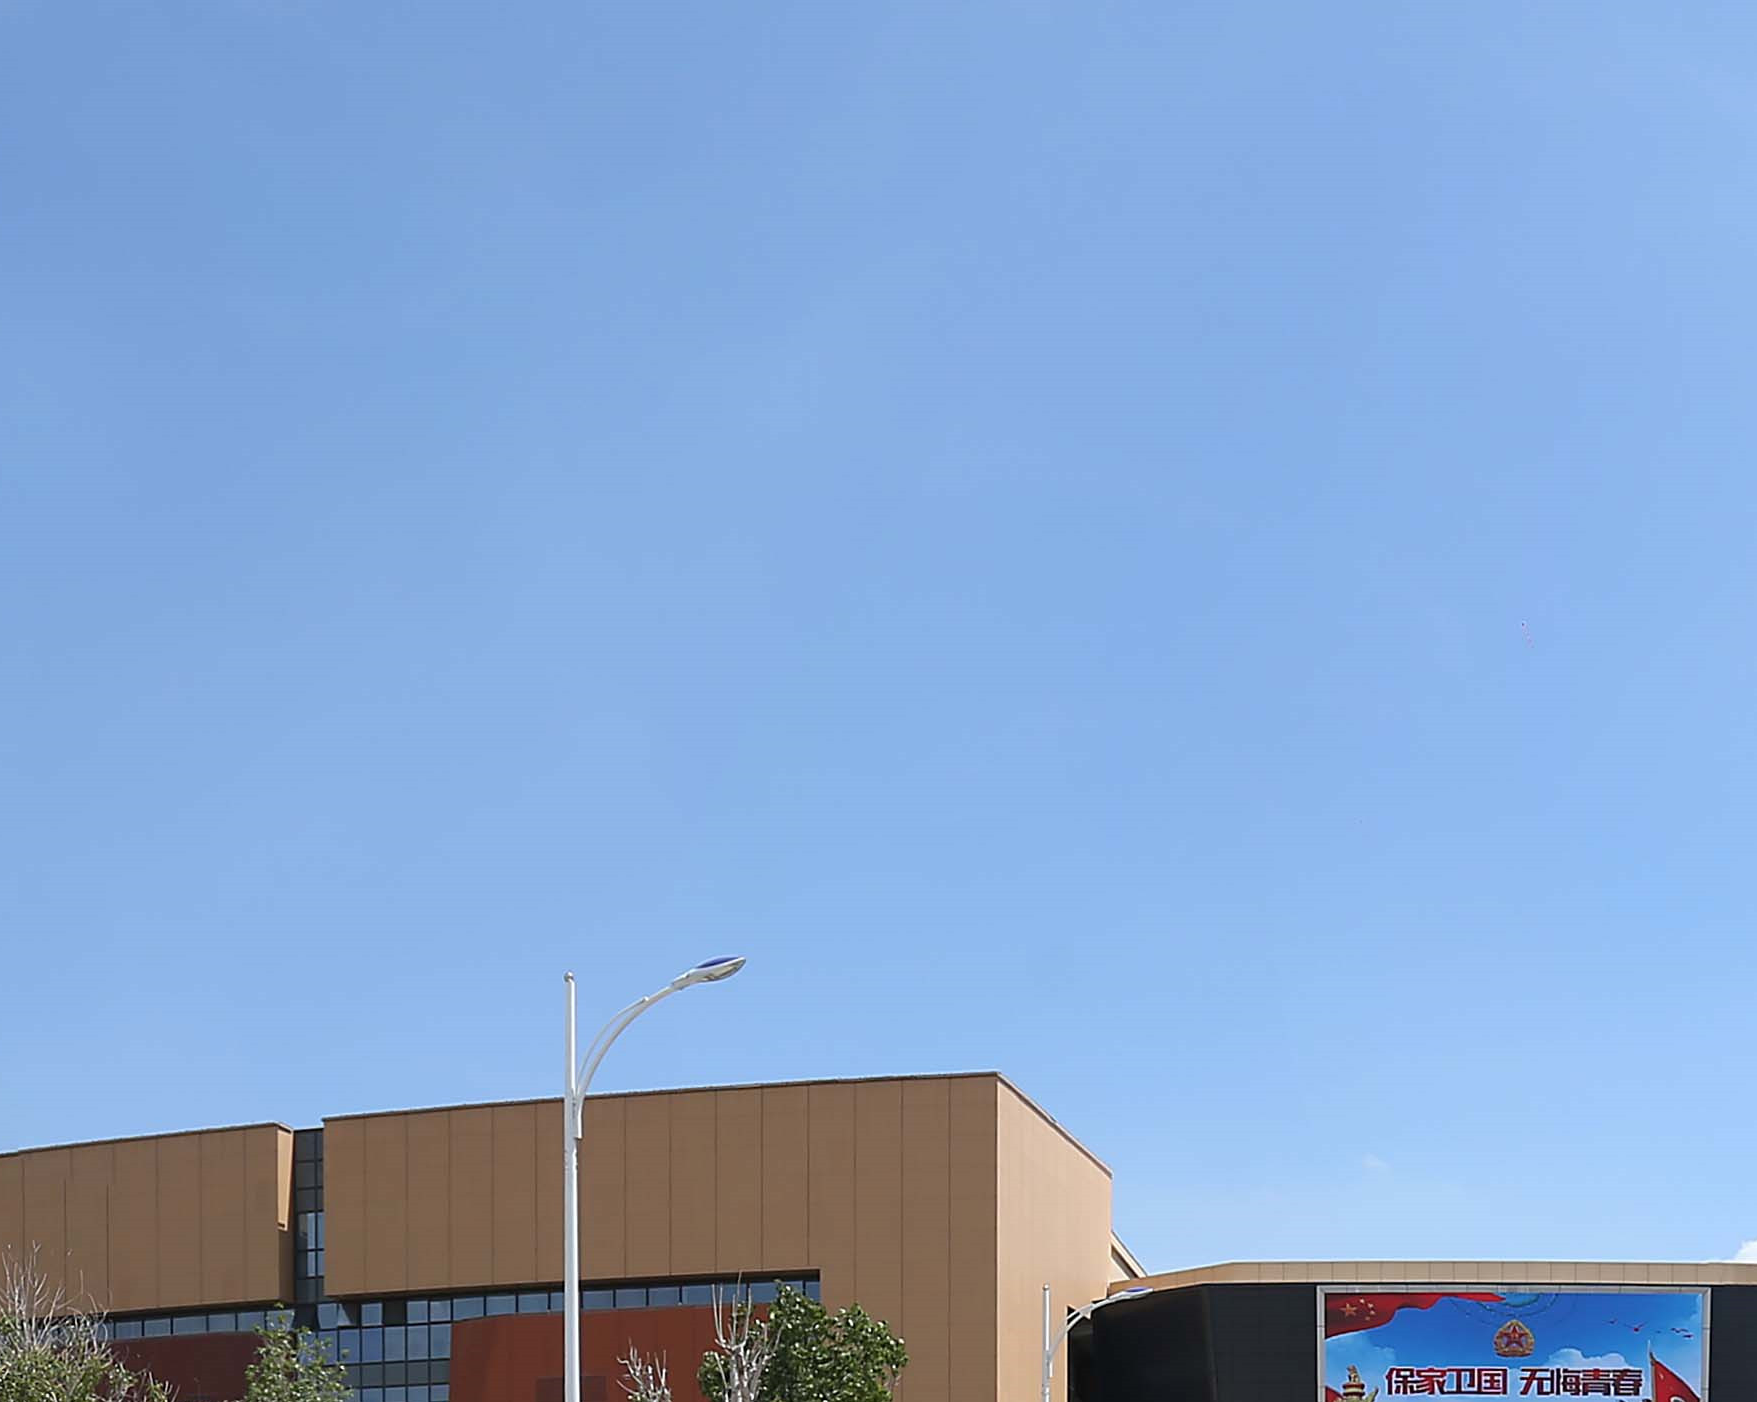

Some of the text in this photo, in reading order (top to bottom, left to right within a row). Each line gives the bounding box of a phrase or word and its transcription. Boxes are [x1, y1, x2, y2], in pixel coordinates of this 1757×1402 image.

[1385, 1367, 1643, 1396] 保家卫国 无悔青春
